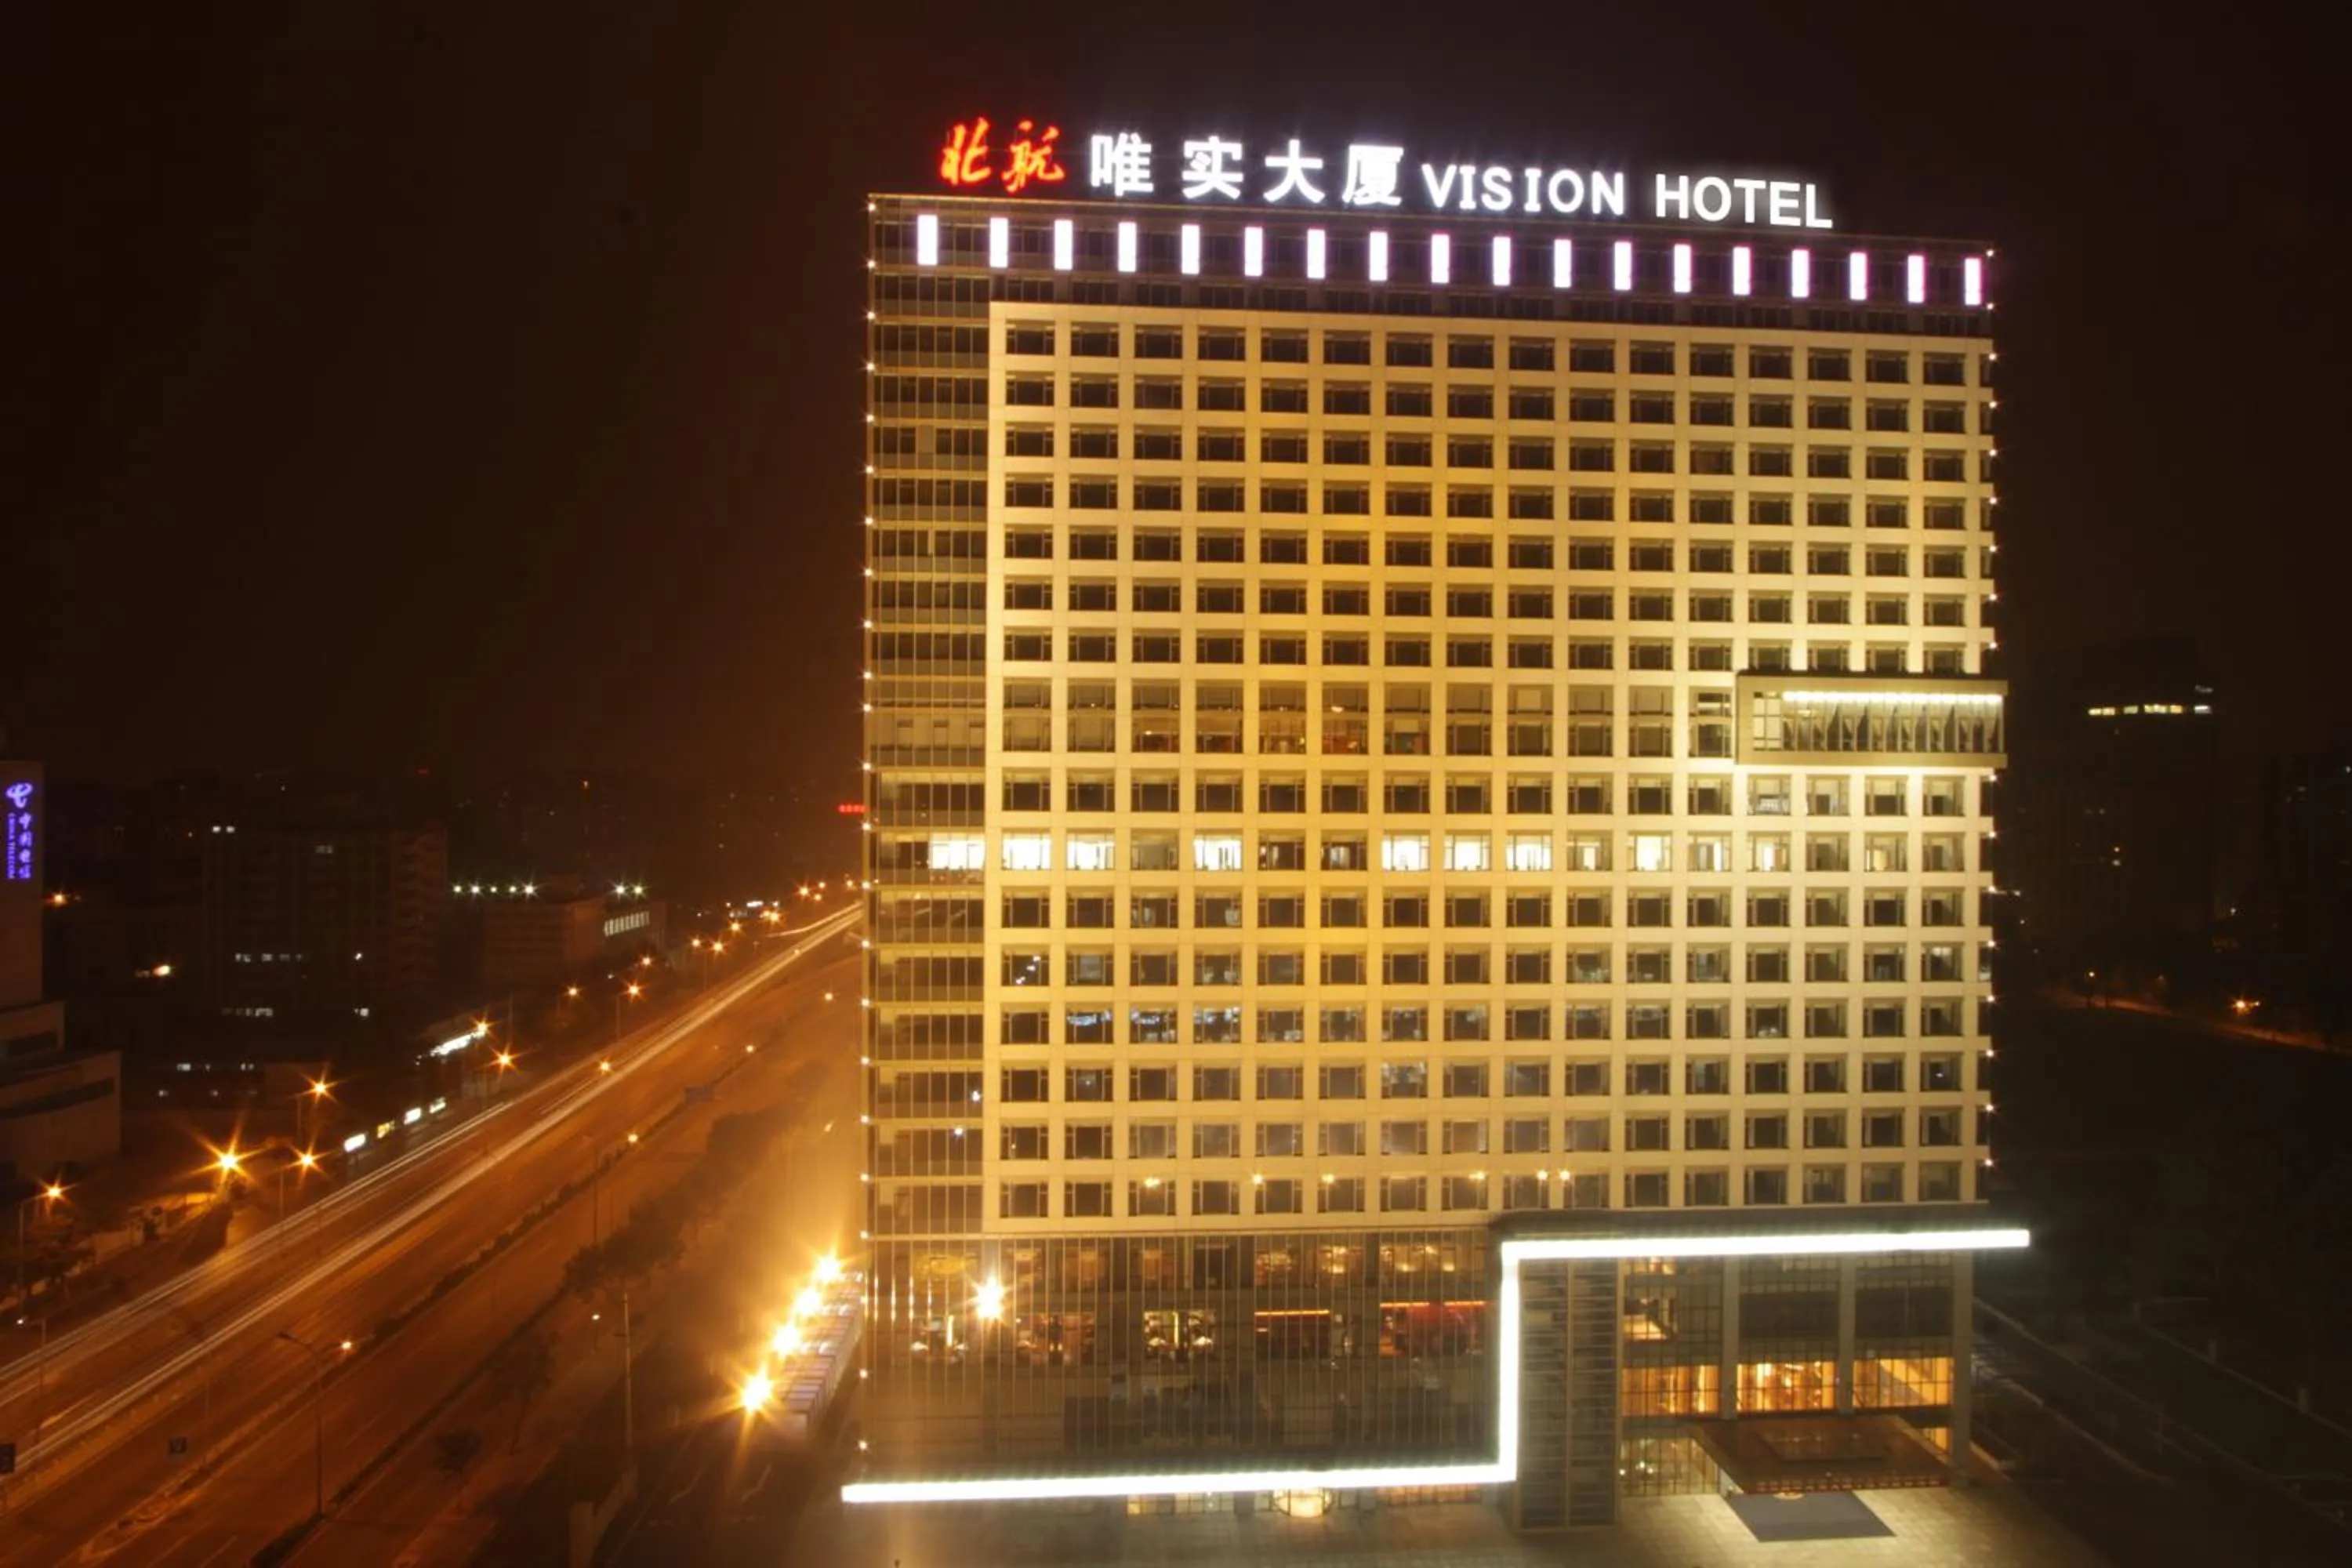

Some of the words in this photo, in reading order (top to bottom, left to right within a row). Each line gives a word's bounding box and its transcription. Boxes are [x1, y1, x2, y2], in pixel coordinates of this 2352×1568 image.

[941, 118, 1065, 192] 北航
[1091, 132, 1404, 207] 唯实大厦
[1421, 163, 1624, 216] VISION
[1656, 173, 1833, 229] HOTEL
